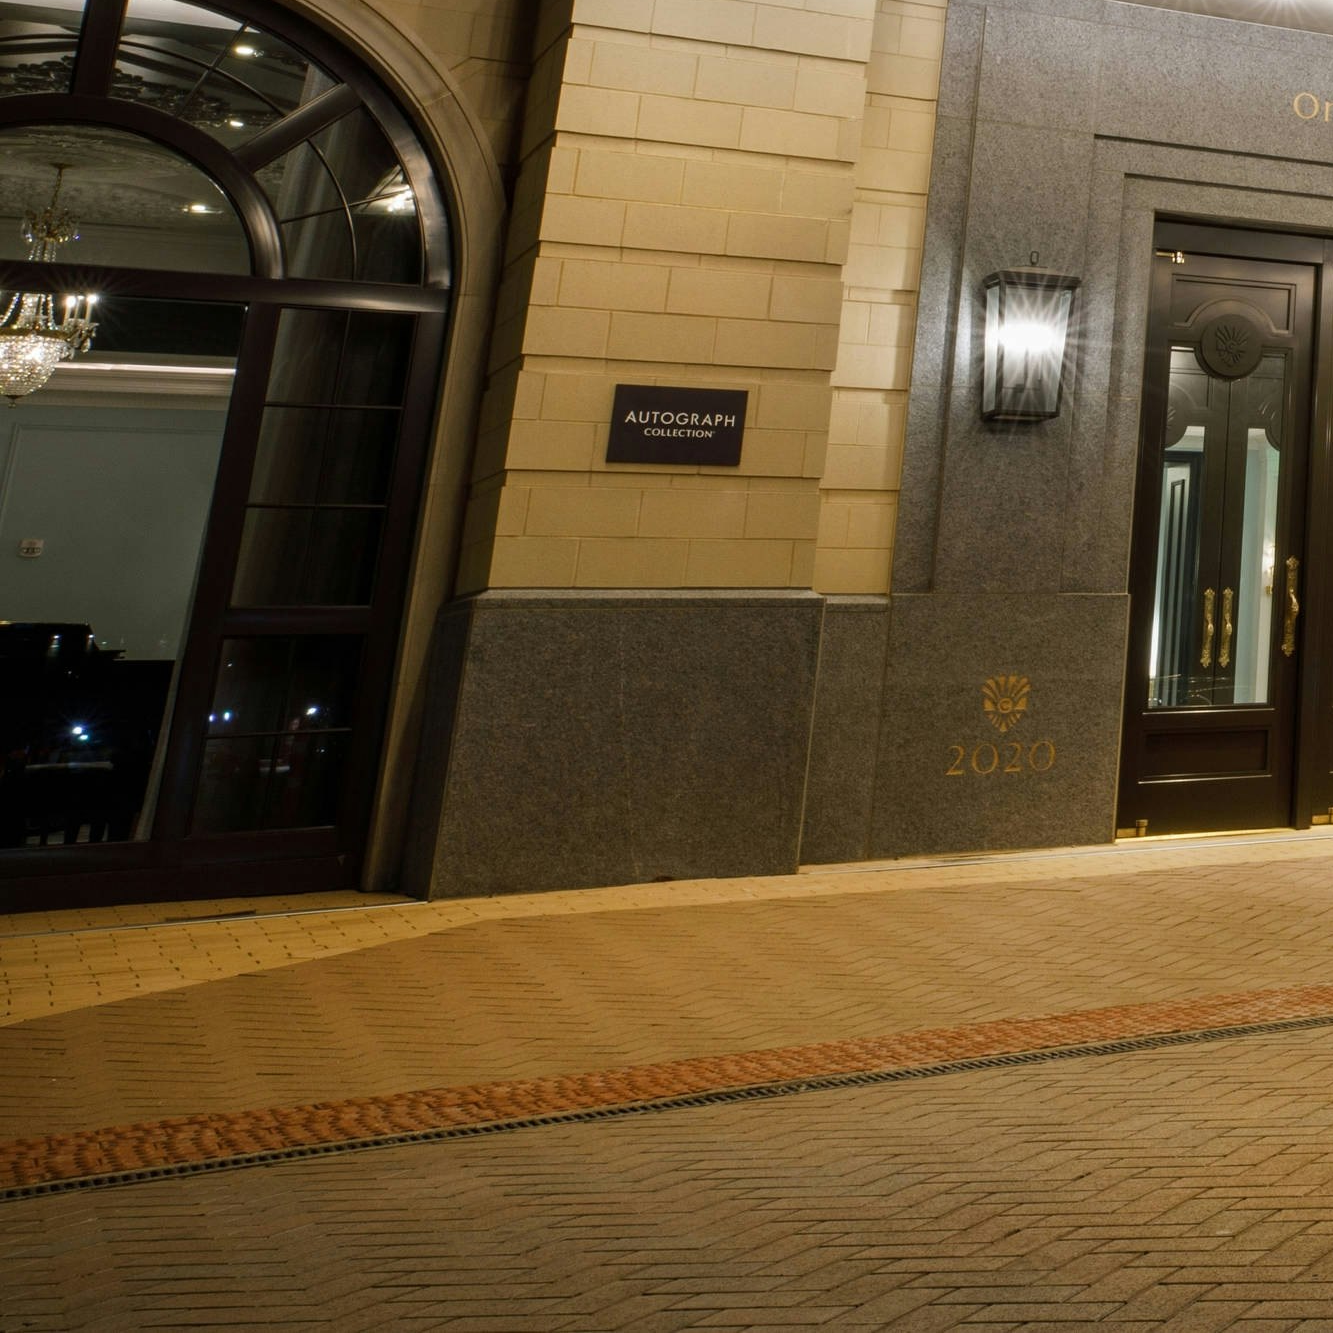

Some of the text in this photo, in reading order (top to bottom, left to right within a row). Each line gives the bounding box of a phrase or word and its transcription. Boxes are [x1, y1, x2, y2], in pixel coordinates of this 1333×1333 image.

[625, 410, 736, 427] AUTOGRAPH
[643, 427, 714, 438] COLLECTION
[945, 741, 1056, 776] 2020
